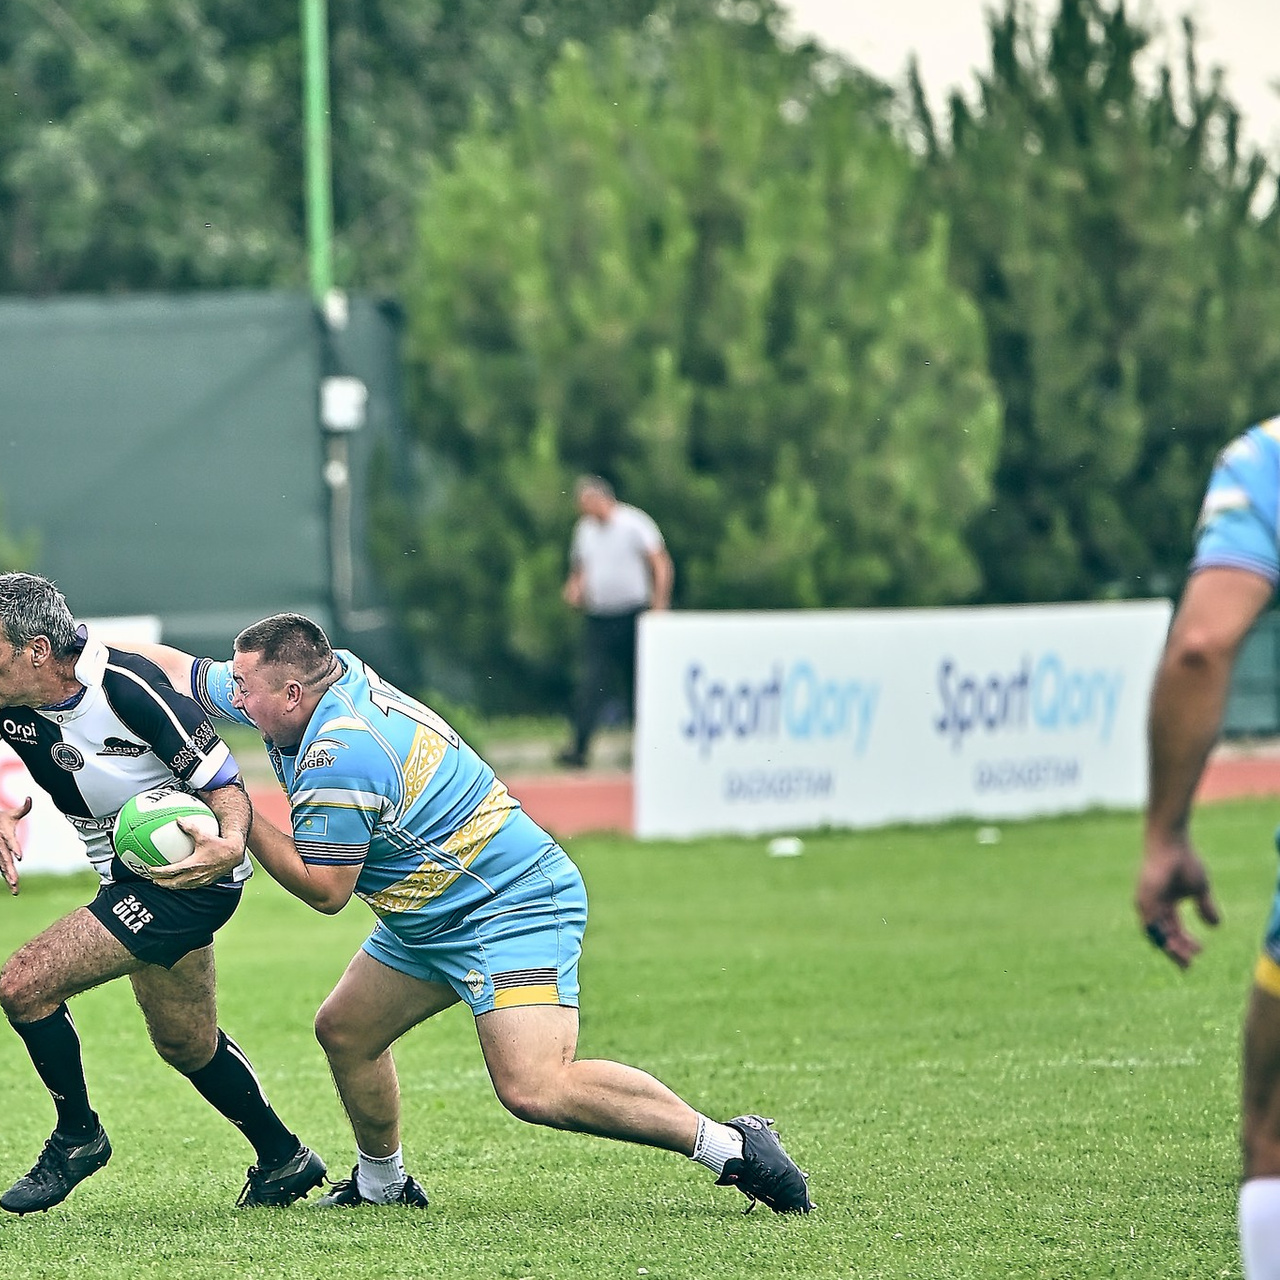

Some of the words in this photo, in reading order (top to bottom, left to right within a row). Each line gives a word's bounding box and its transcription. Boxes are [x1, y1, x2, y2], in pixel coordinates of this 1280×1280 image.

[3, 719, 37, 738] Orpi
[297, 756, 335, 775] UGBY
[112, 901, 144, 934] ULLA
